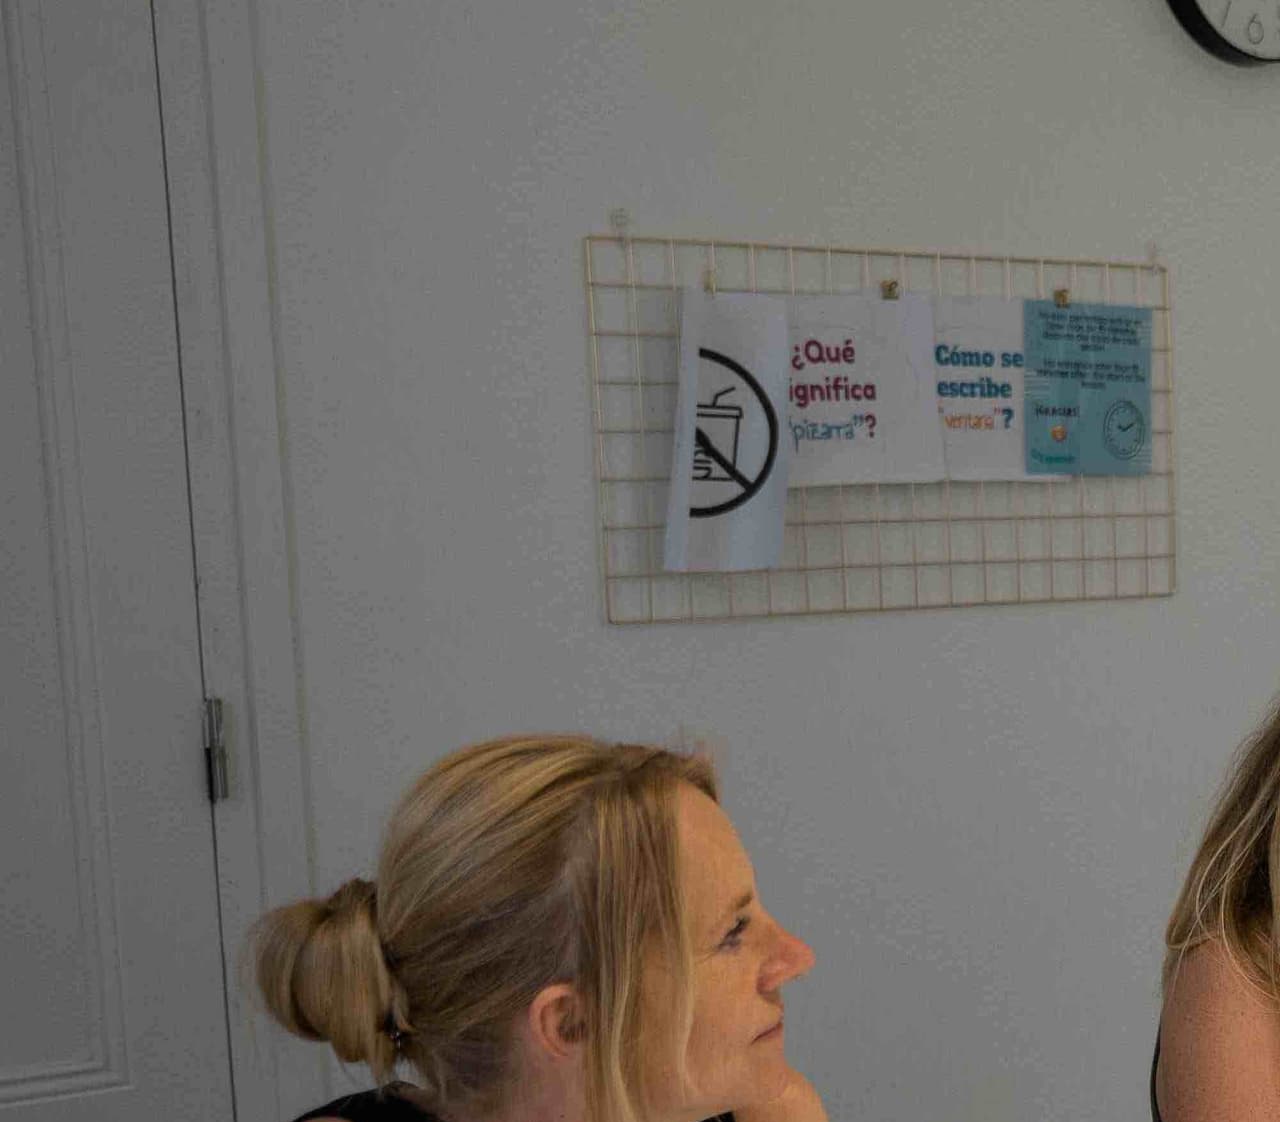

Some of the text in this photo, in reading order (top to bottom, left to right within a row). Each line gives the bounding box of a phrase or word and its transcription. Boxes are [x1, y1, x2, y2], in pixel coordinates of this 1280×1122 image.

[1248, 14, 1264, 45] 6
[791, 339, 855, 371] ¿Qué
[935, 344, 1024, 368] Cómo se
[789, 375, 876, 408] ignifica
[937, 377, 1012, 399] escribe
